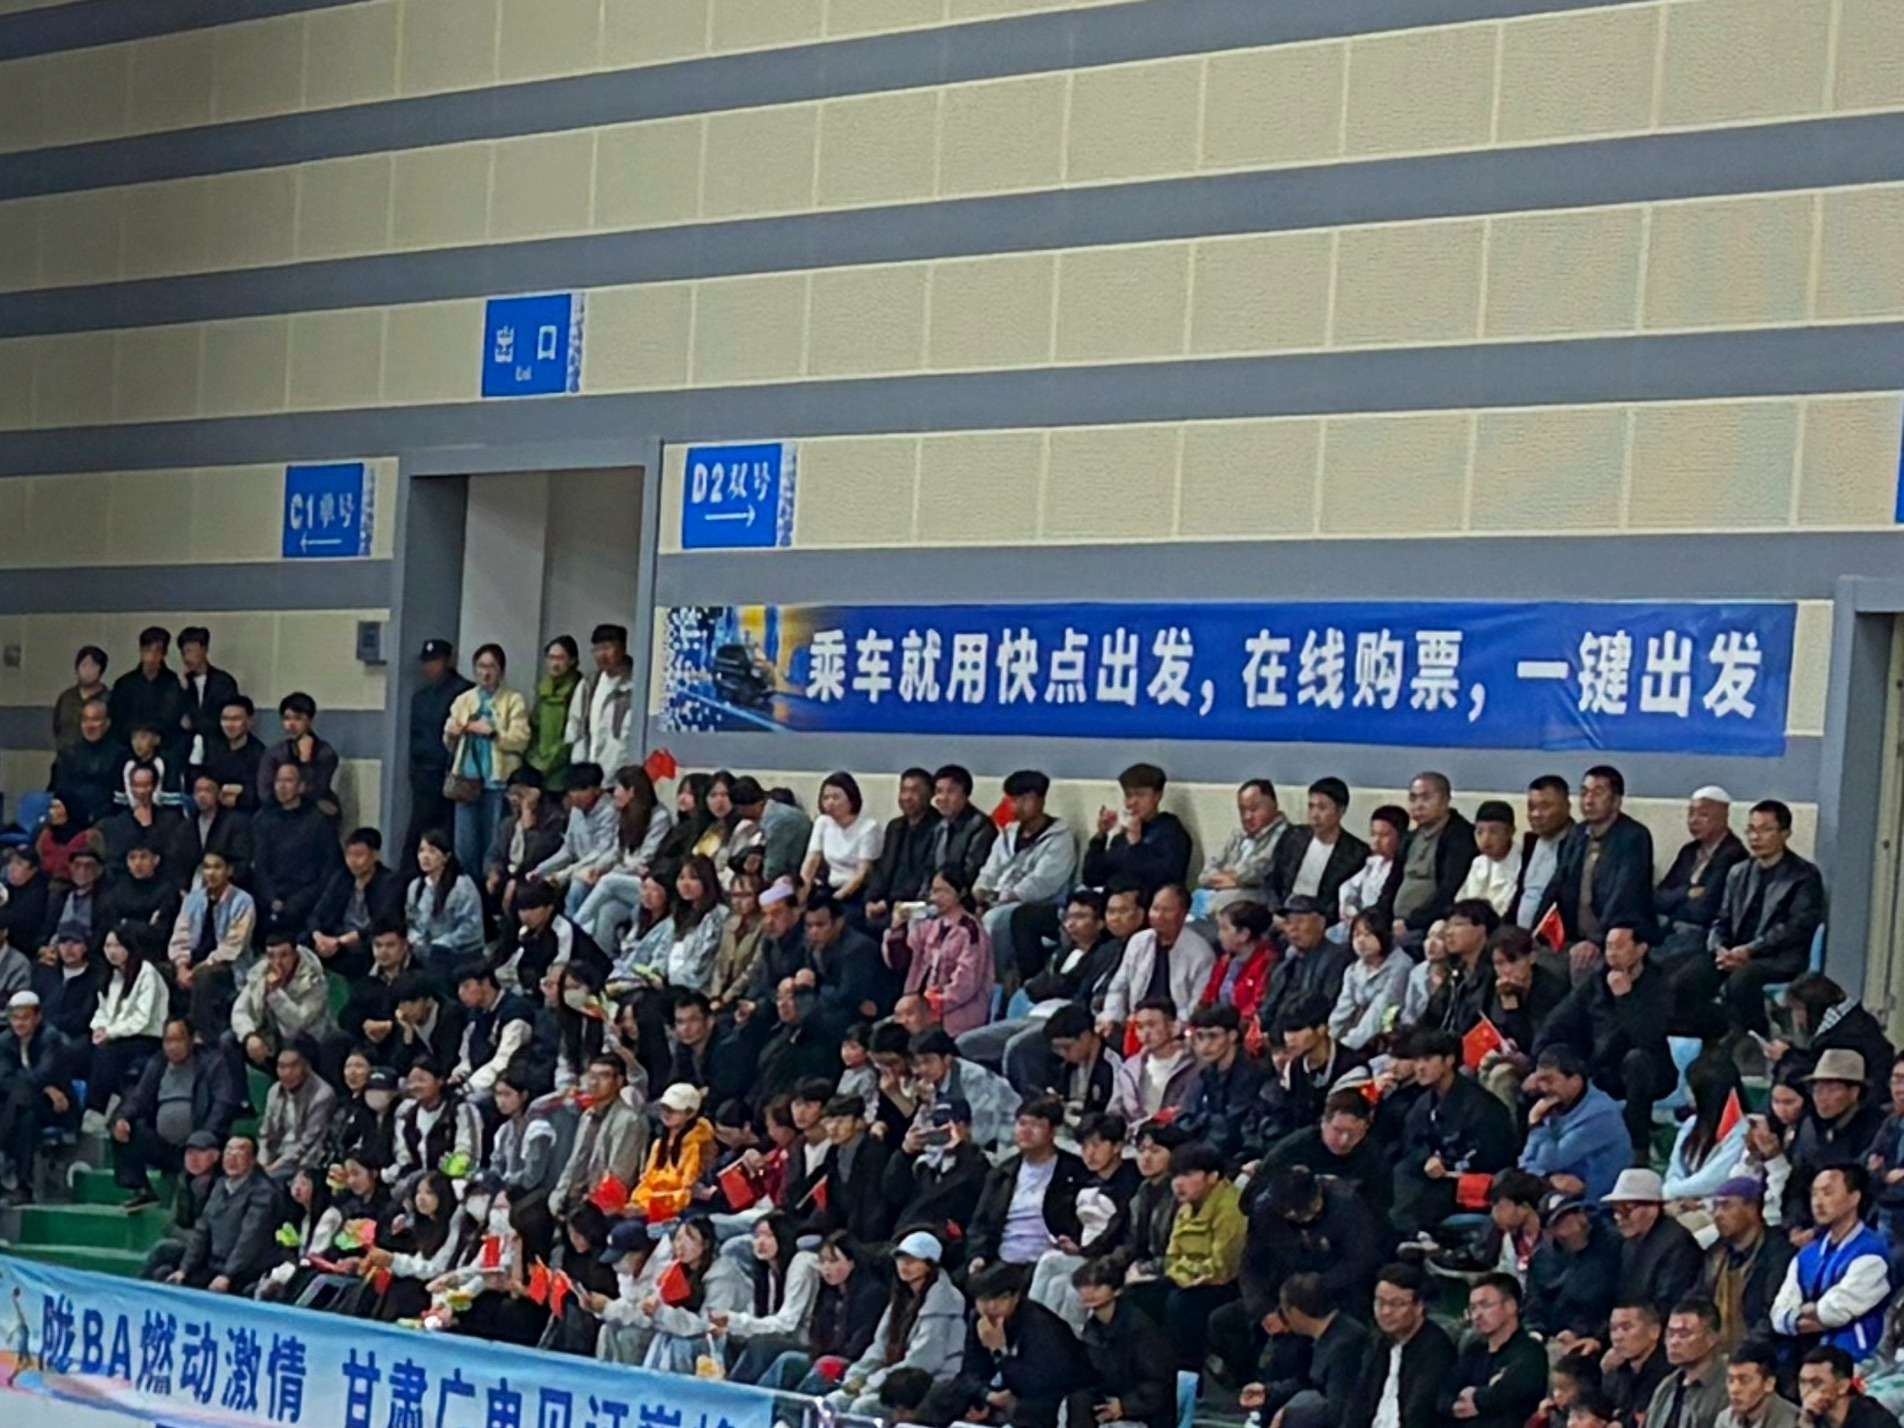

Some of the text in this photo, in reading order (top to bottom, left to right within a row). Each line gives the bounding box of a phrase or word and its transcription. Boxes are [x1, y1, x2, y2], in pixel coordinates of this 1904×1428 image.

[494, 325, 557, 363] 出口
[692, 461, 771, 504] D2双号
[290, 493, 355, 530] C1单号
[40, 1295, 308, 1424] 陇BA燃动激情
